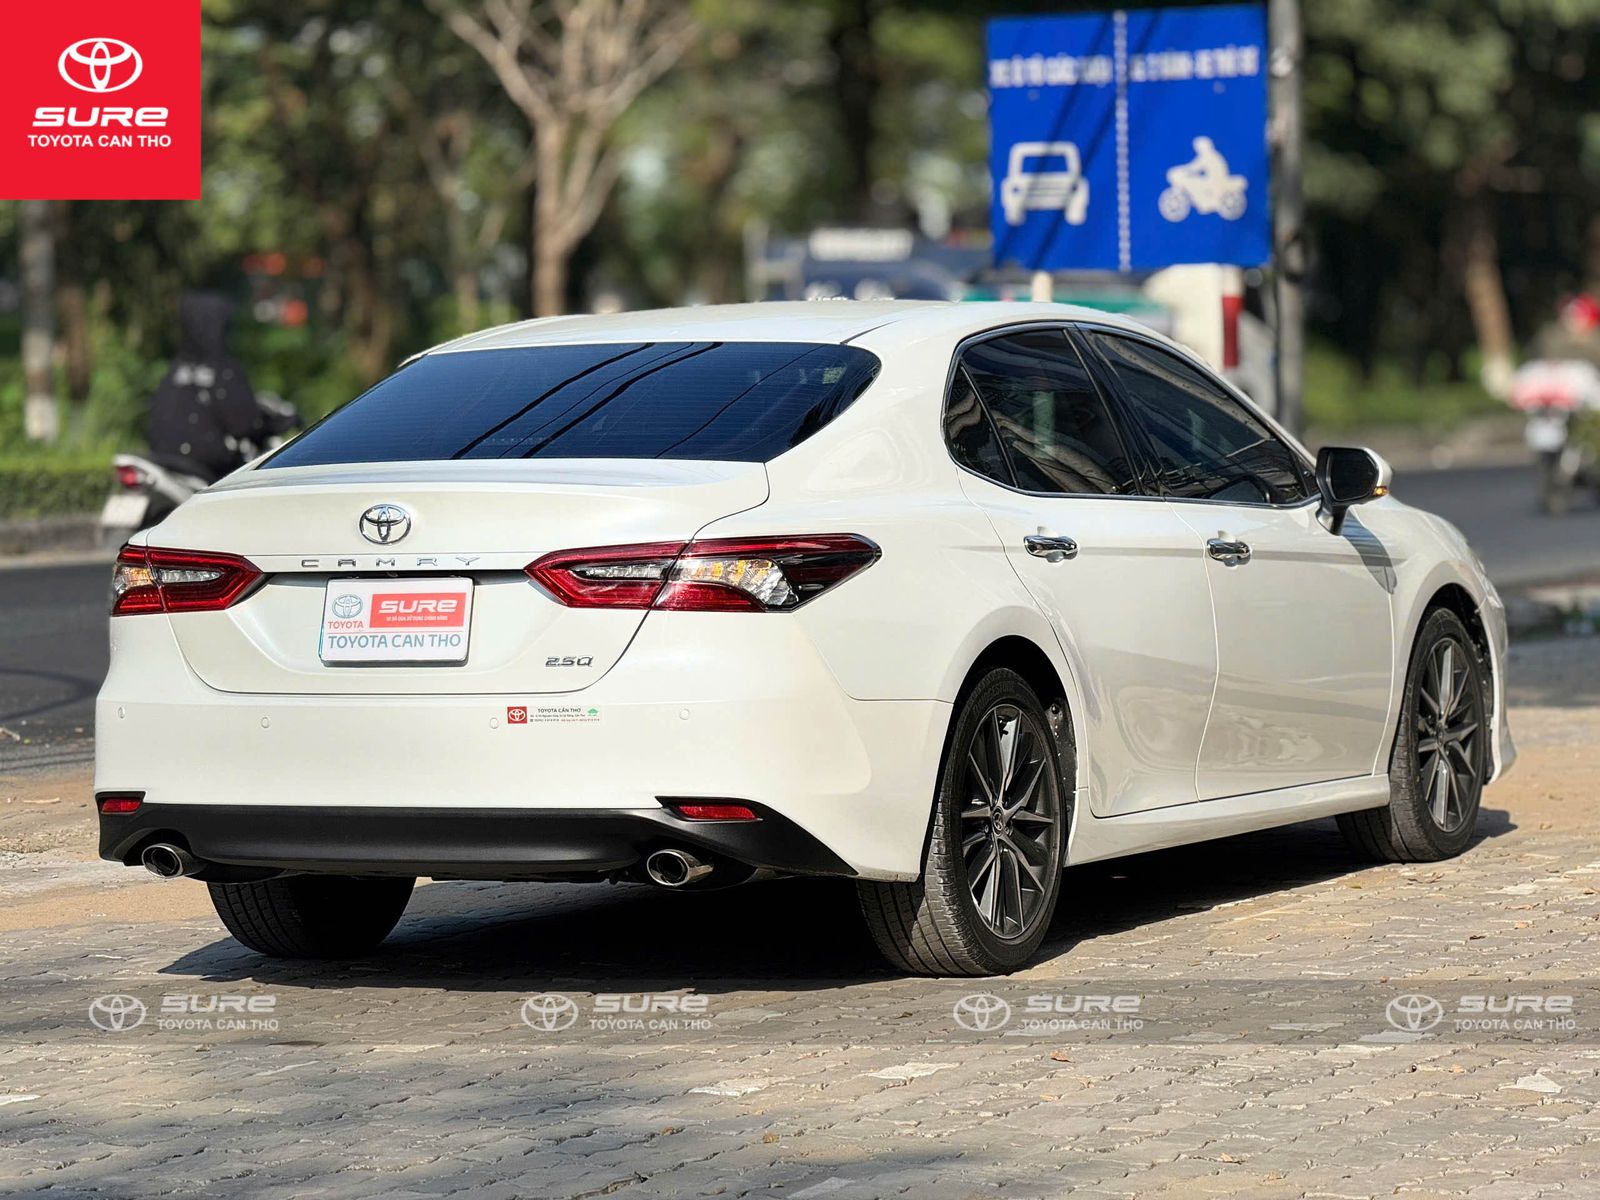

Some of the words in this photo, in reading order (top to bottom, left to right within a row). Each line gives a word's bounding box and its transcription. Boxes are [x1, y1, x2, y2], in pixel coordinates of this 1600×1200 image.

[301, 557, 480, 567] CAMRY
[327, 621, 364, 629] TOYOTA
[328, 635, 388, 648] TOYOTA
[391, 634, 424, 648] CAN
[428, 634, 461, 647] THO
